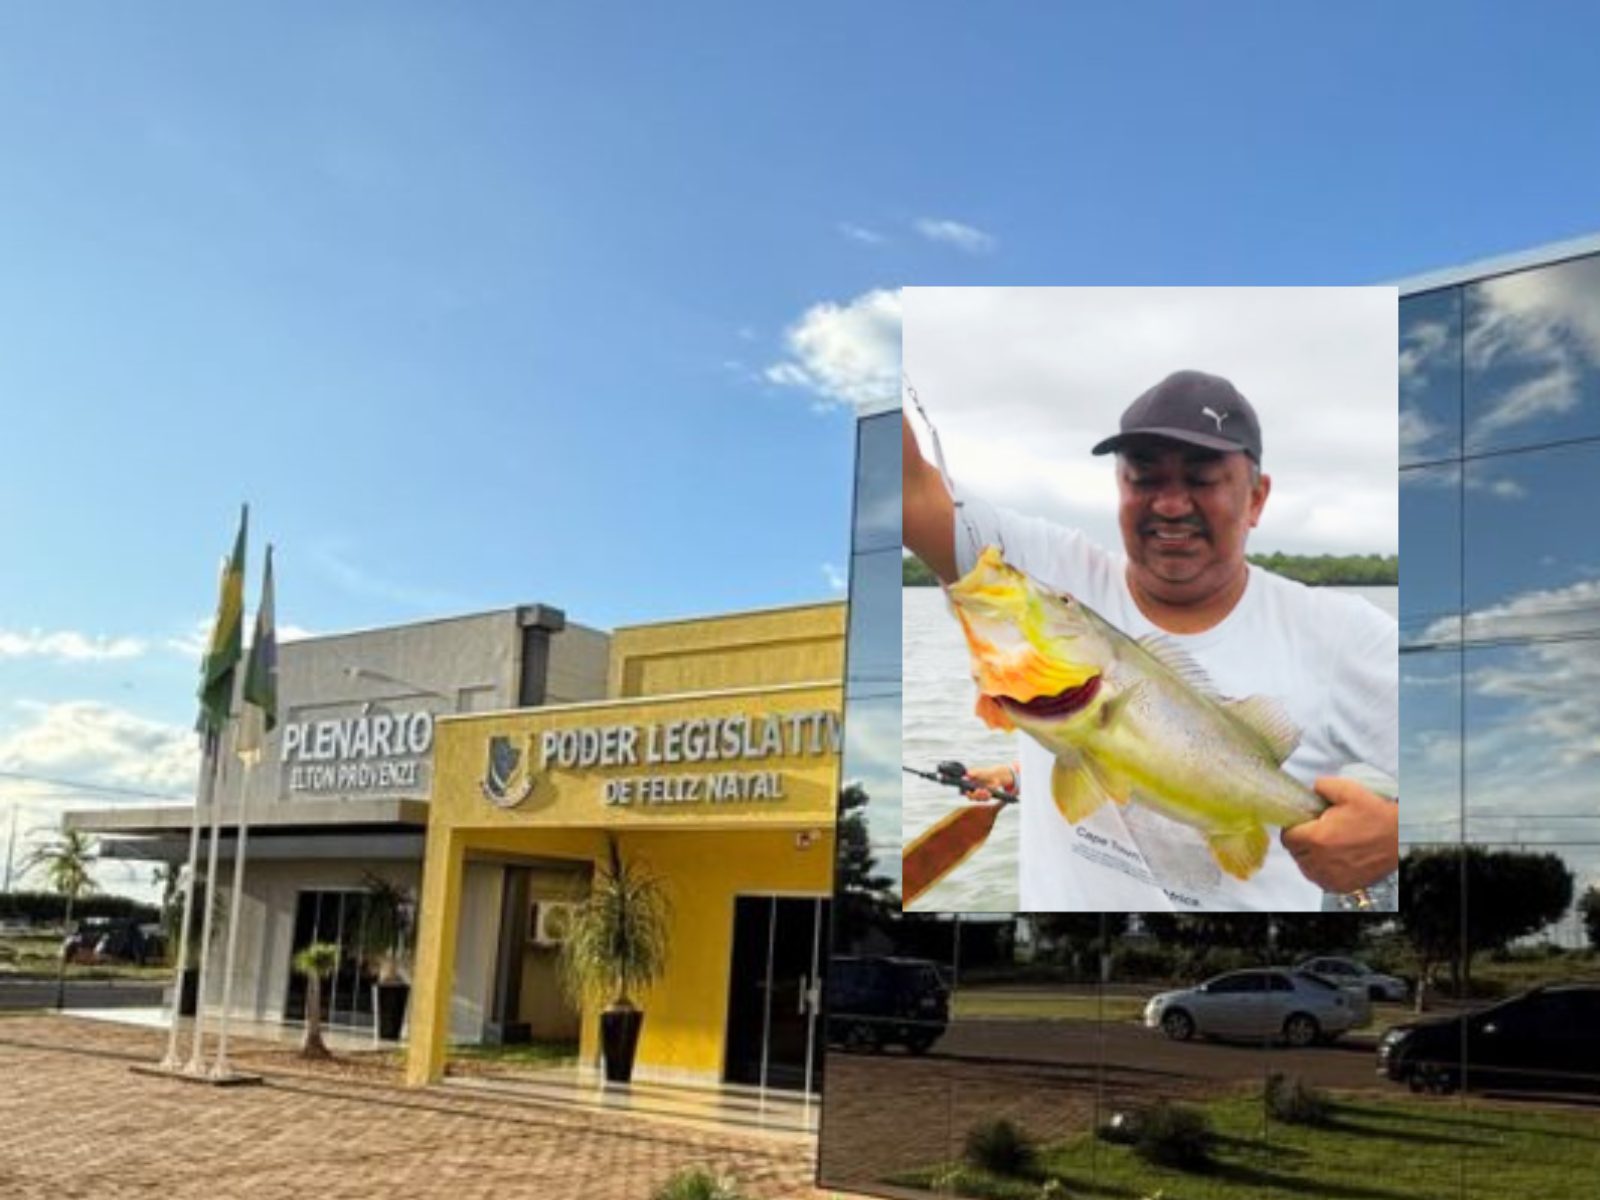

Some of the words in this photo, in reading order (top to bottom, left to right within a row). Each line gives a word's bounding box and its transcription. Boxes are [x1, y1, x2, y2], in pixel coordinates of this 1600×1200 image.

[281, 702, 433, 763] PLENÁRIO
[540, 723, 639, 768] PODER
[338, 761, 417, 787] PROVENZI
[606, 779, 632, 805] DE
[640, 776, 699, 802] FELIZ
[706, 772, 783, 800] NATAL
[1076, 826, 1107, 846] Cape
